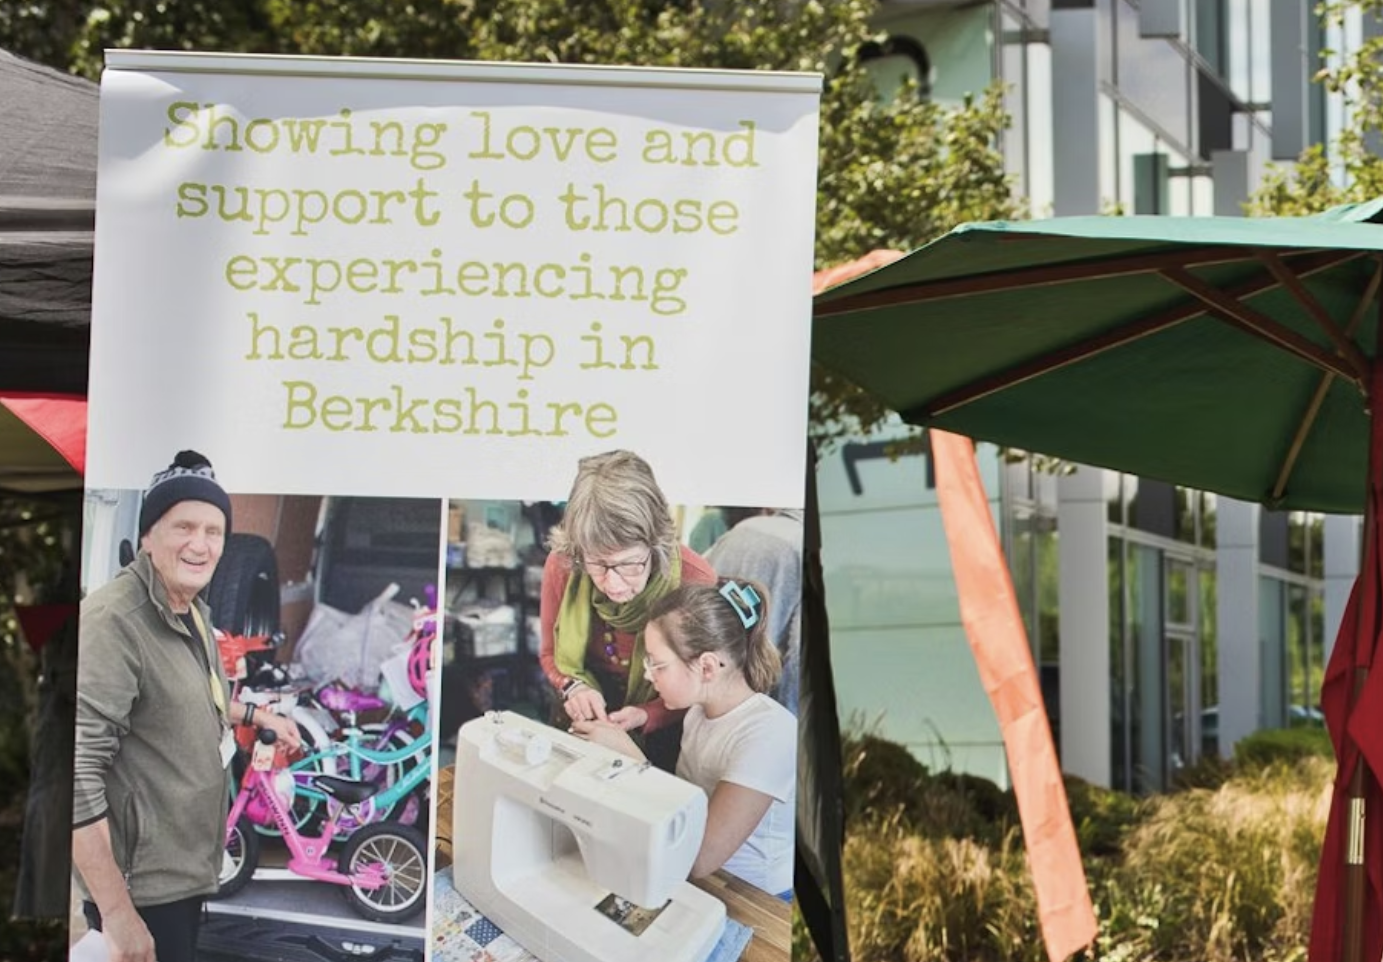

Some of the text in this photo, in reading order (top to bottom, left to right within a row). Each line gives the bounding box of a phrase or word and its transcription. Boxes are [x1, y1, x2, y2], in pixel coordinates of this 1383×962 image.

[165, 100, 758, 170] Showing love and
[176, 179, 739, 236] support to those
[225, 248, 688, 315] experiencing
[246, 312, 659, 380] hardship in
[282, 380, 618, 438] Berkshire
